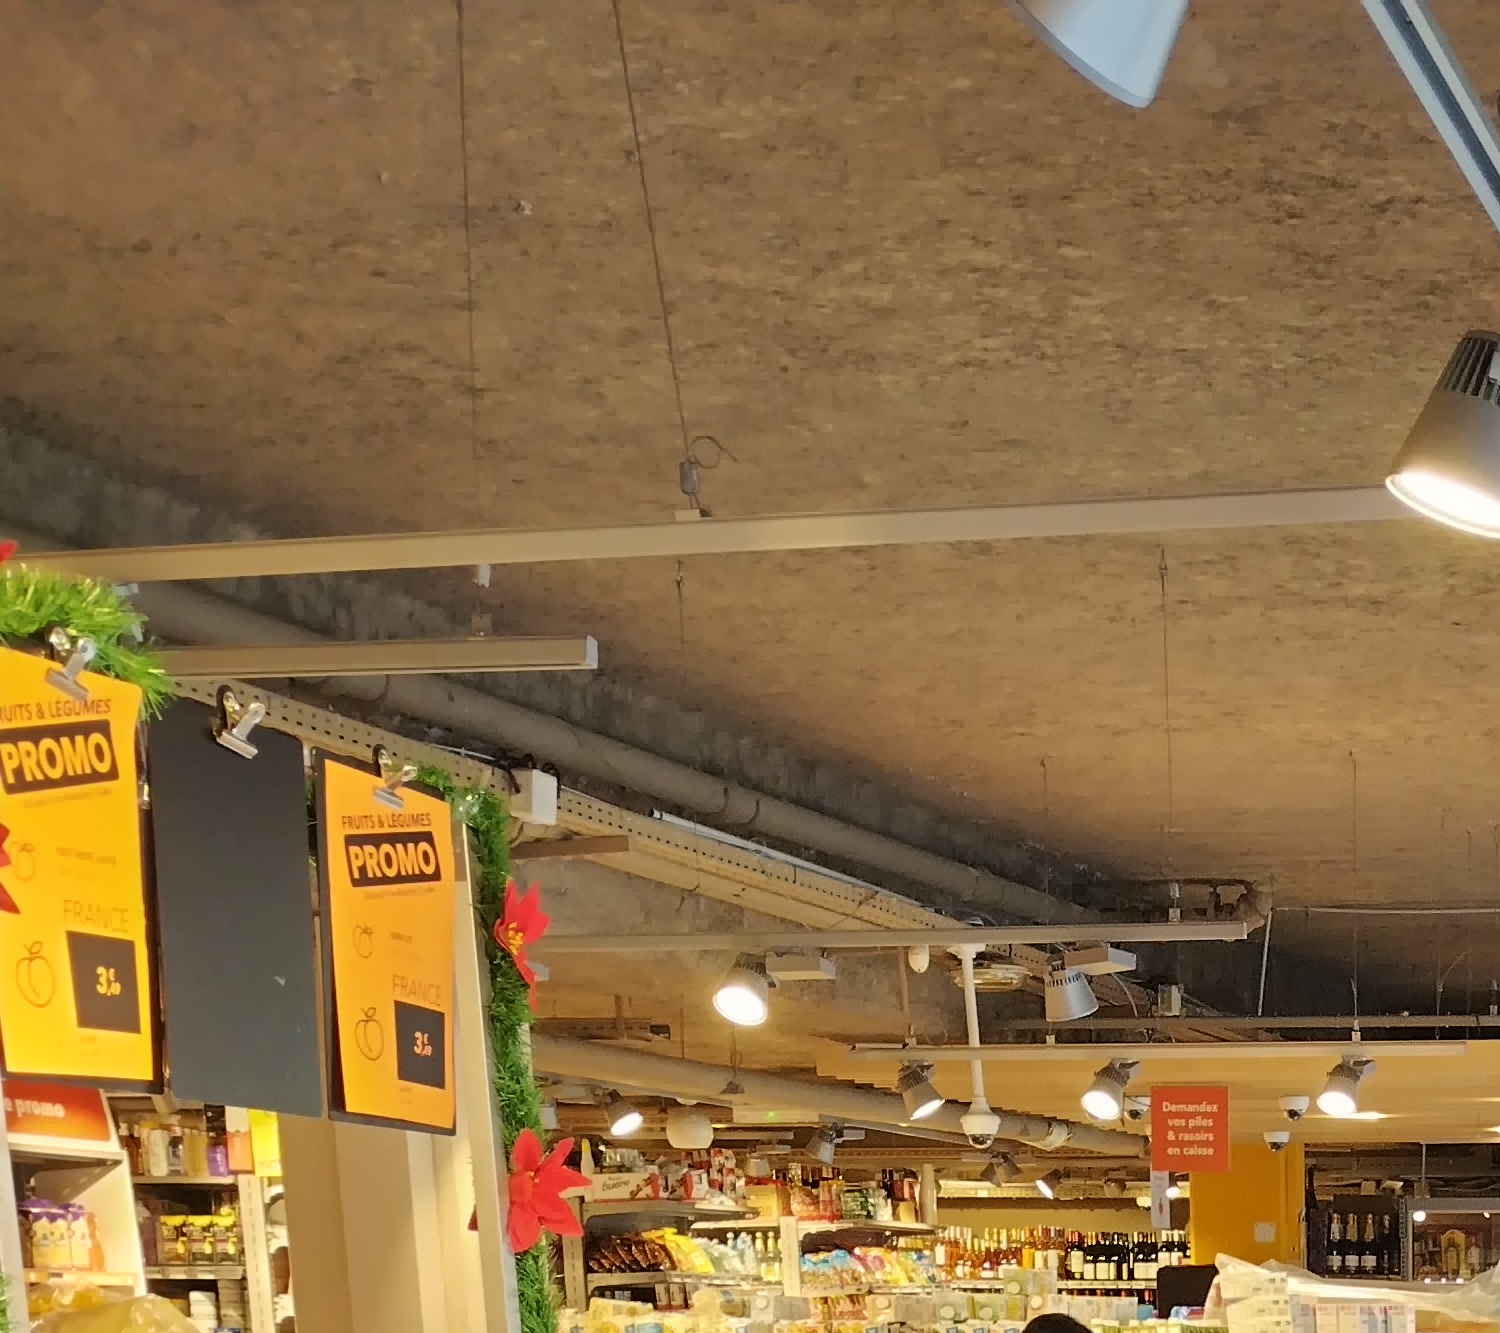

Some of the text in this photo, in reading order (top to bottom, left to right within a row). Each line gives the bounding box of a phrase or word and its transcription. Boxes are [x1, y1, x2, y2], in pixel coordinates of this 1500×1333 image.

[36, 703, 45, 719] &
[1, 733, 112, 784] PROMO
[341, 815, 375, 830] FRUITS
[378, 814, 385, 828] &
[348, 841, 436, 879] PROMO
[63, 900, 129, 934] FRANCE
[392, 974, 441, 1007] FRANCE
[15, 1098, 65, 1119] promo
[1162, 1101, 1219, 1112] Demandez
[1167, 1116, 1214, 1129] vos piles
[1167, 1130, 1176, 1141] &
[1167, 1144, 1215, 1156] en caisse
